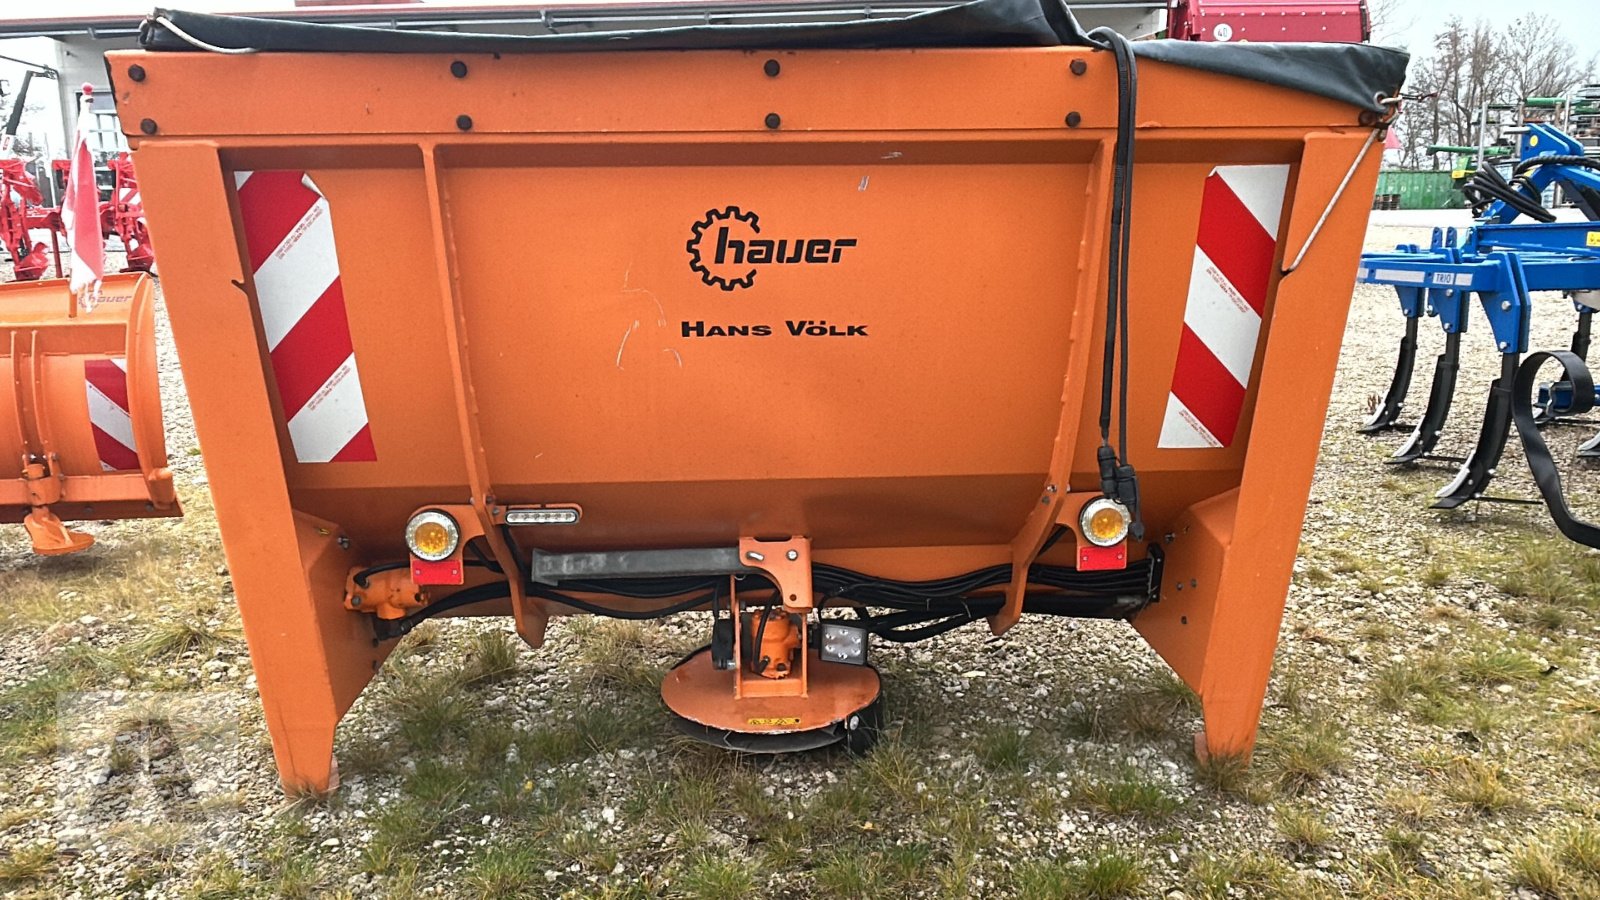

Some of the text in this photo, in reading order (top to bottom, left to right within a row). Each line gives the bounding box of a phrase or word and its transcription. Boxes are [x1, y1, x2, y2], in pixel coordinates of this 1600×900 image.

[714, 226, 857, 264] hauer
[681, 320, 869, 337] HANS VÖLK
